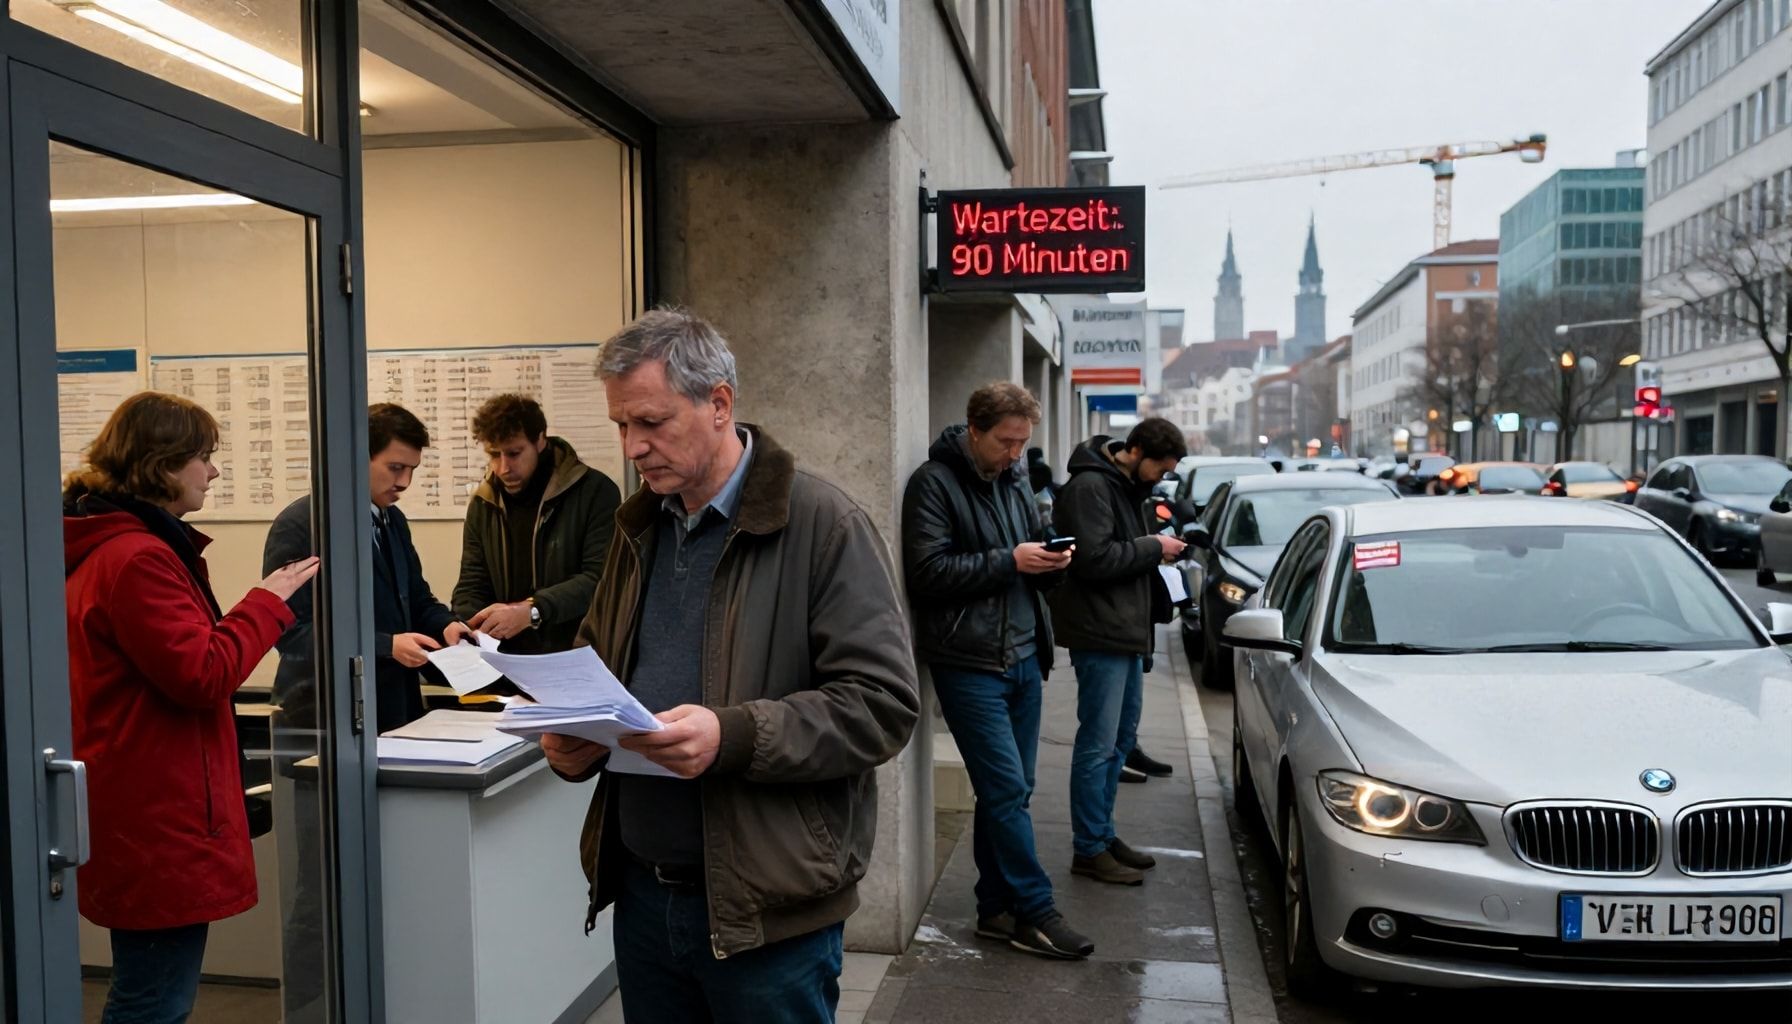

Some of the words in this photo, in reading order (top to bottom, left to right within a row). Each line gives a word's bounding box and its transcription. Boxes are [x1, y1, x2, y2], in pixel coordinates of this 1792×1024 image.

[953, 200, 1124, 235] Wartezeit:
[952, 244, 993, 275] 90
[1003, 241, 1127, 274] Minuten
